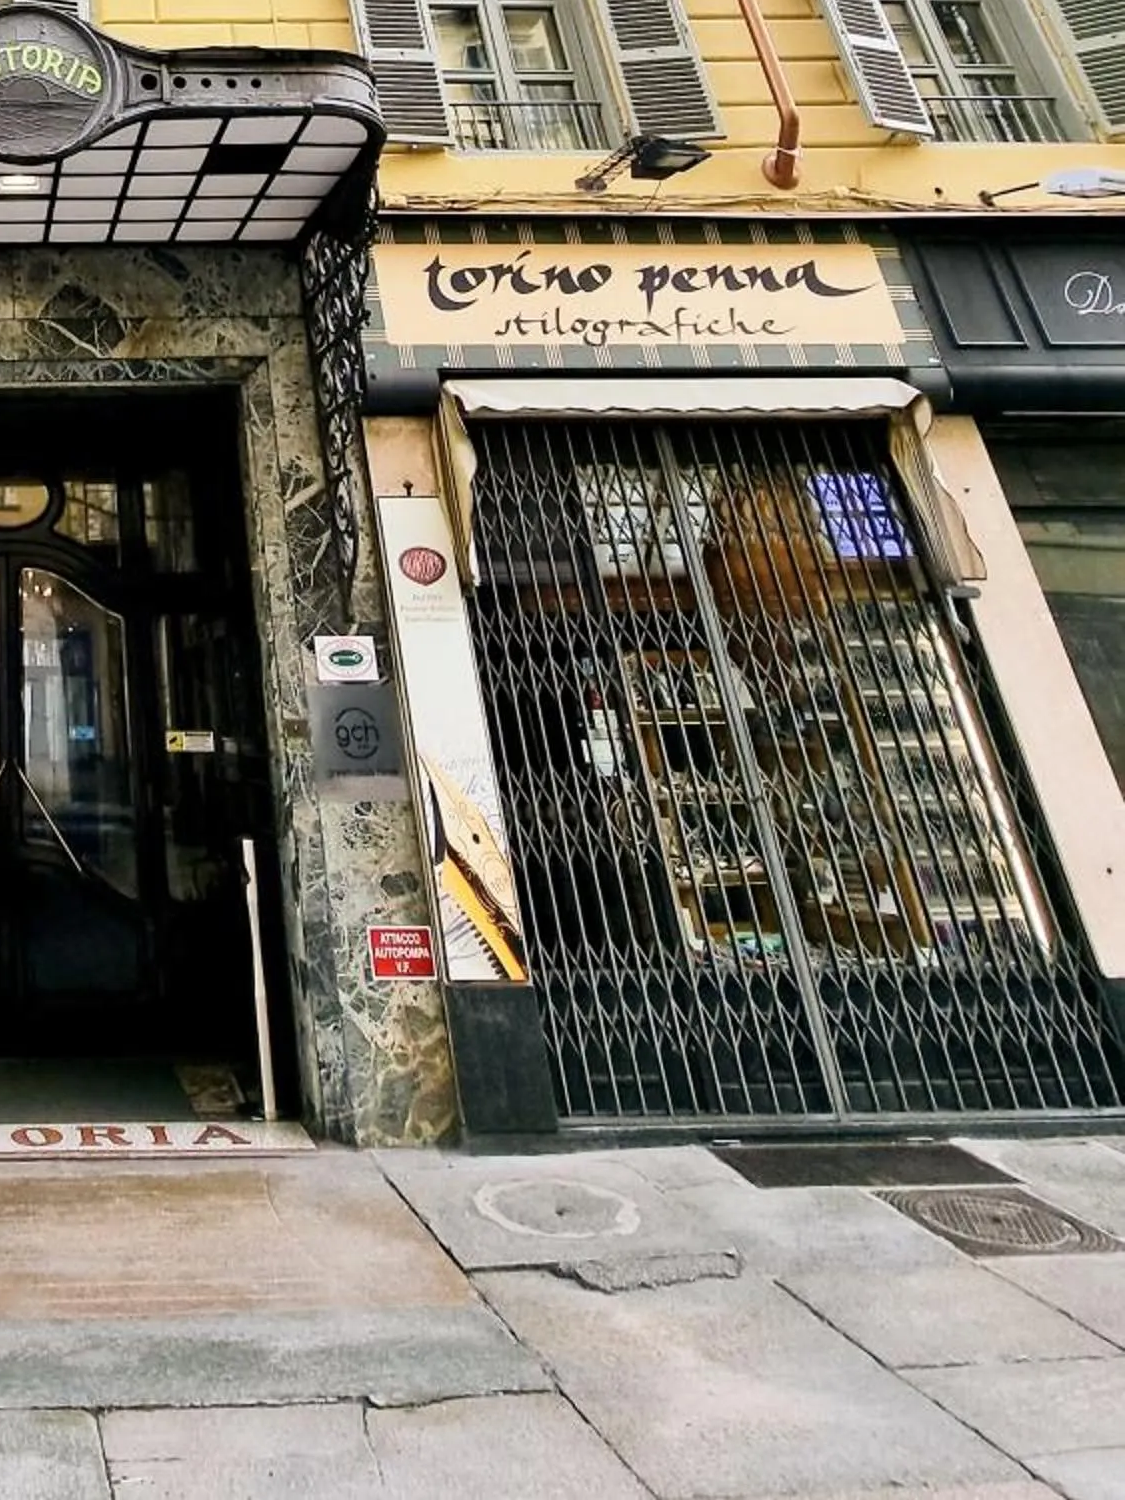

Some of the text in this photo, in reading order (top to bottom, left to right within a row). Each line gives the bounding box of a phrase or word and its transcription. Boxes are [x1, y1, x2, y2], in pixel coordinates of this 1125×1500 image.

[423, 250, 878, 315] torino penna
[495, 307, 796, 347] stilografiche
